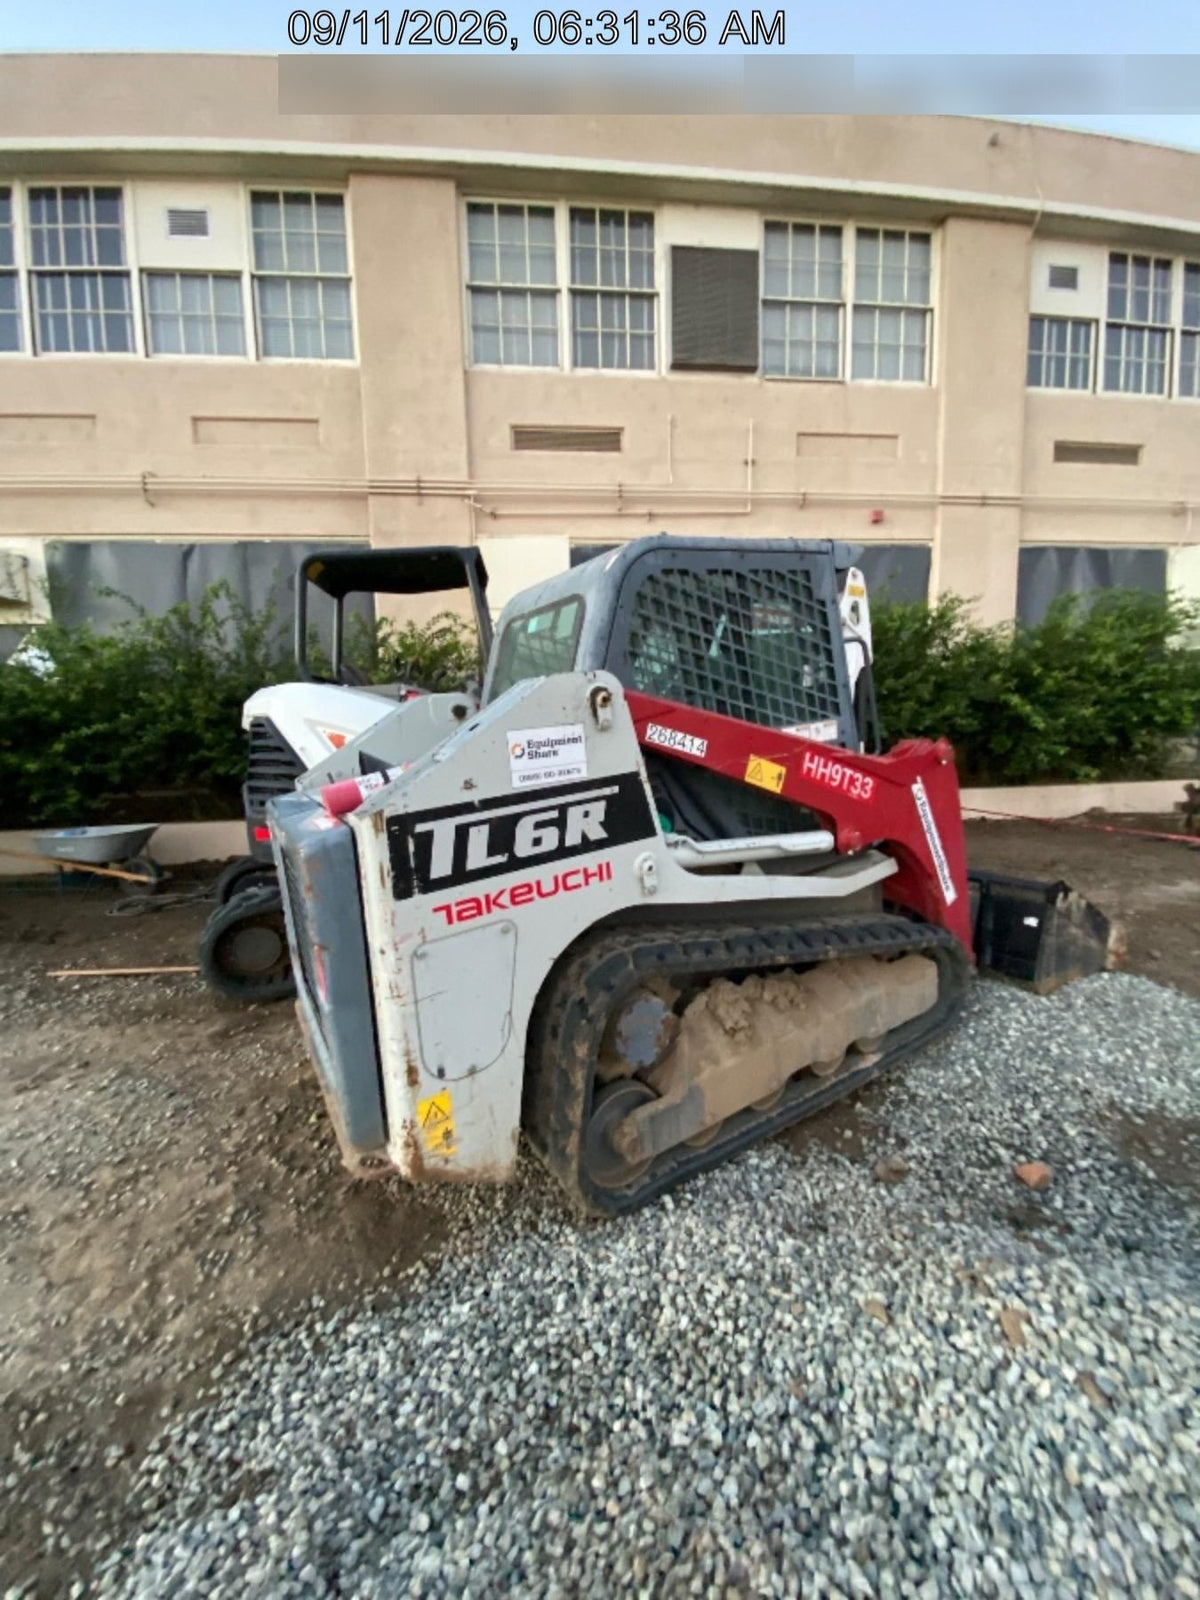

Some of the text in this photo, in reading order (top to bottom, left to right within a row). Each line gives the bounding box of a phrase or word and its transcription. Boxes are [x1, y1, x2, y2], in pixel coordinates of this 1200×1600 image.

[526, 733, 583, 750] Equipment
[647, 725, 706, 755] 268414
[802, 752, 874, 799] HH9T33
[414, 787, 618, 880] TL6R
